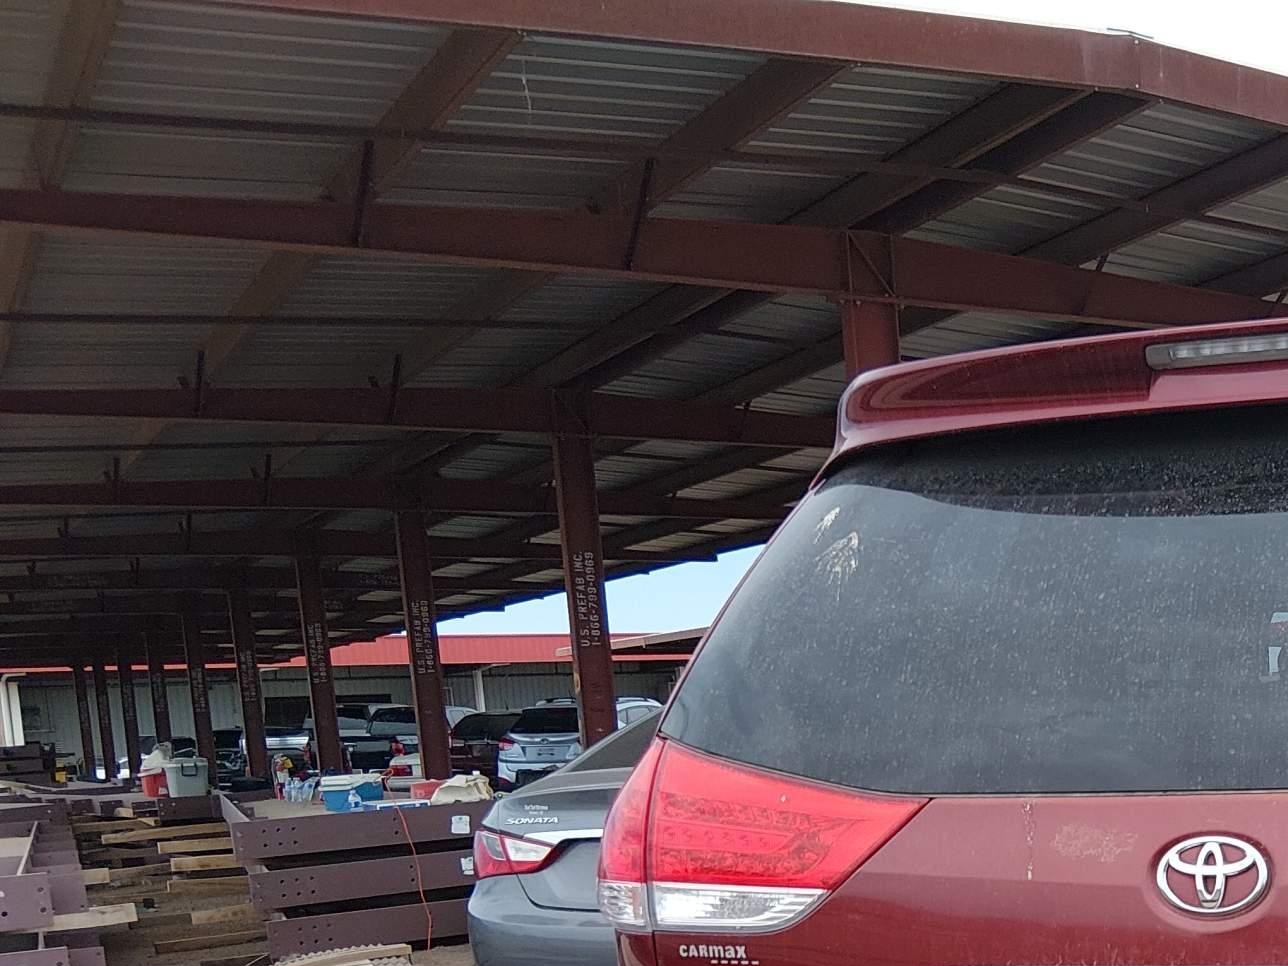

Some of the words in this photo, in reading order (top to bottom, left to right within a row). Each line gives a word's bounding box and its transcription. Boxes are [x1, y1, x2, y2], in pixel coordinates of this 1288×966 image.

[573, 551, 584, 572] INC.
[575, 577, 588, 620] PREFAB
[580, 625, 591, 647] U.S.
[505, 816, 559, 825] SONATA
